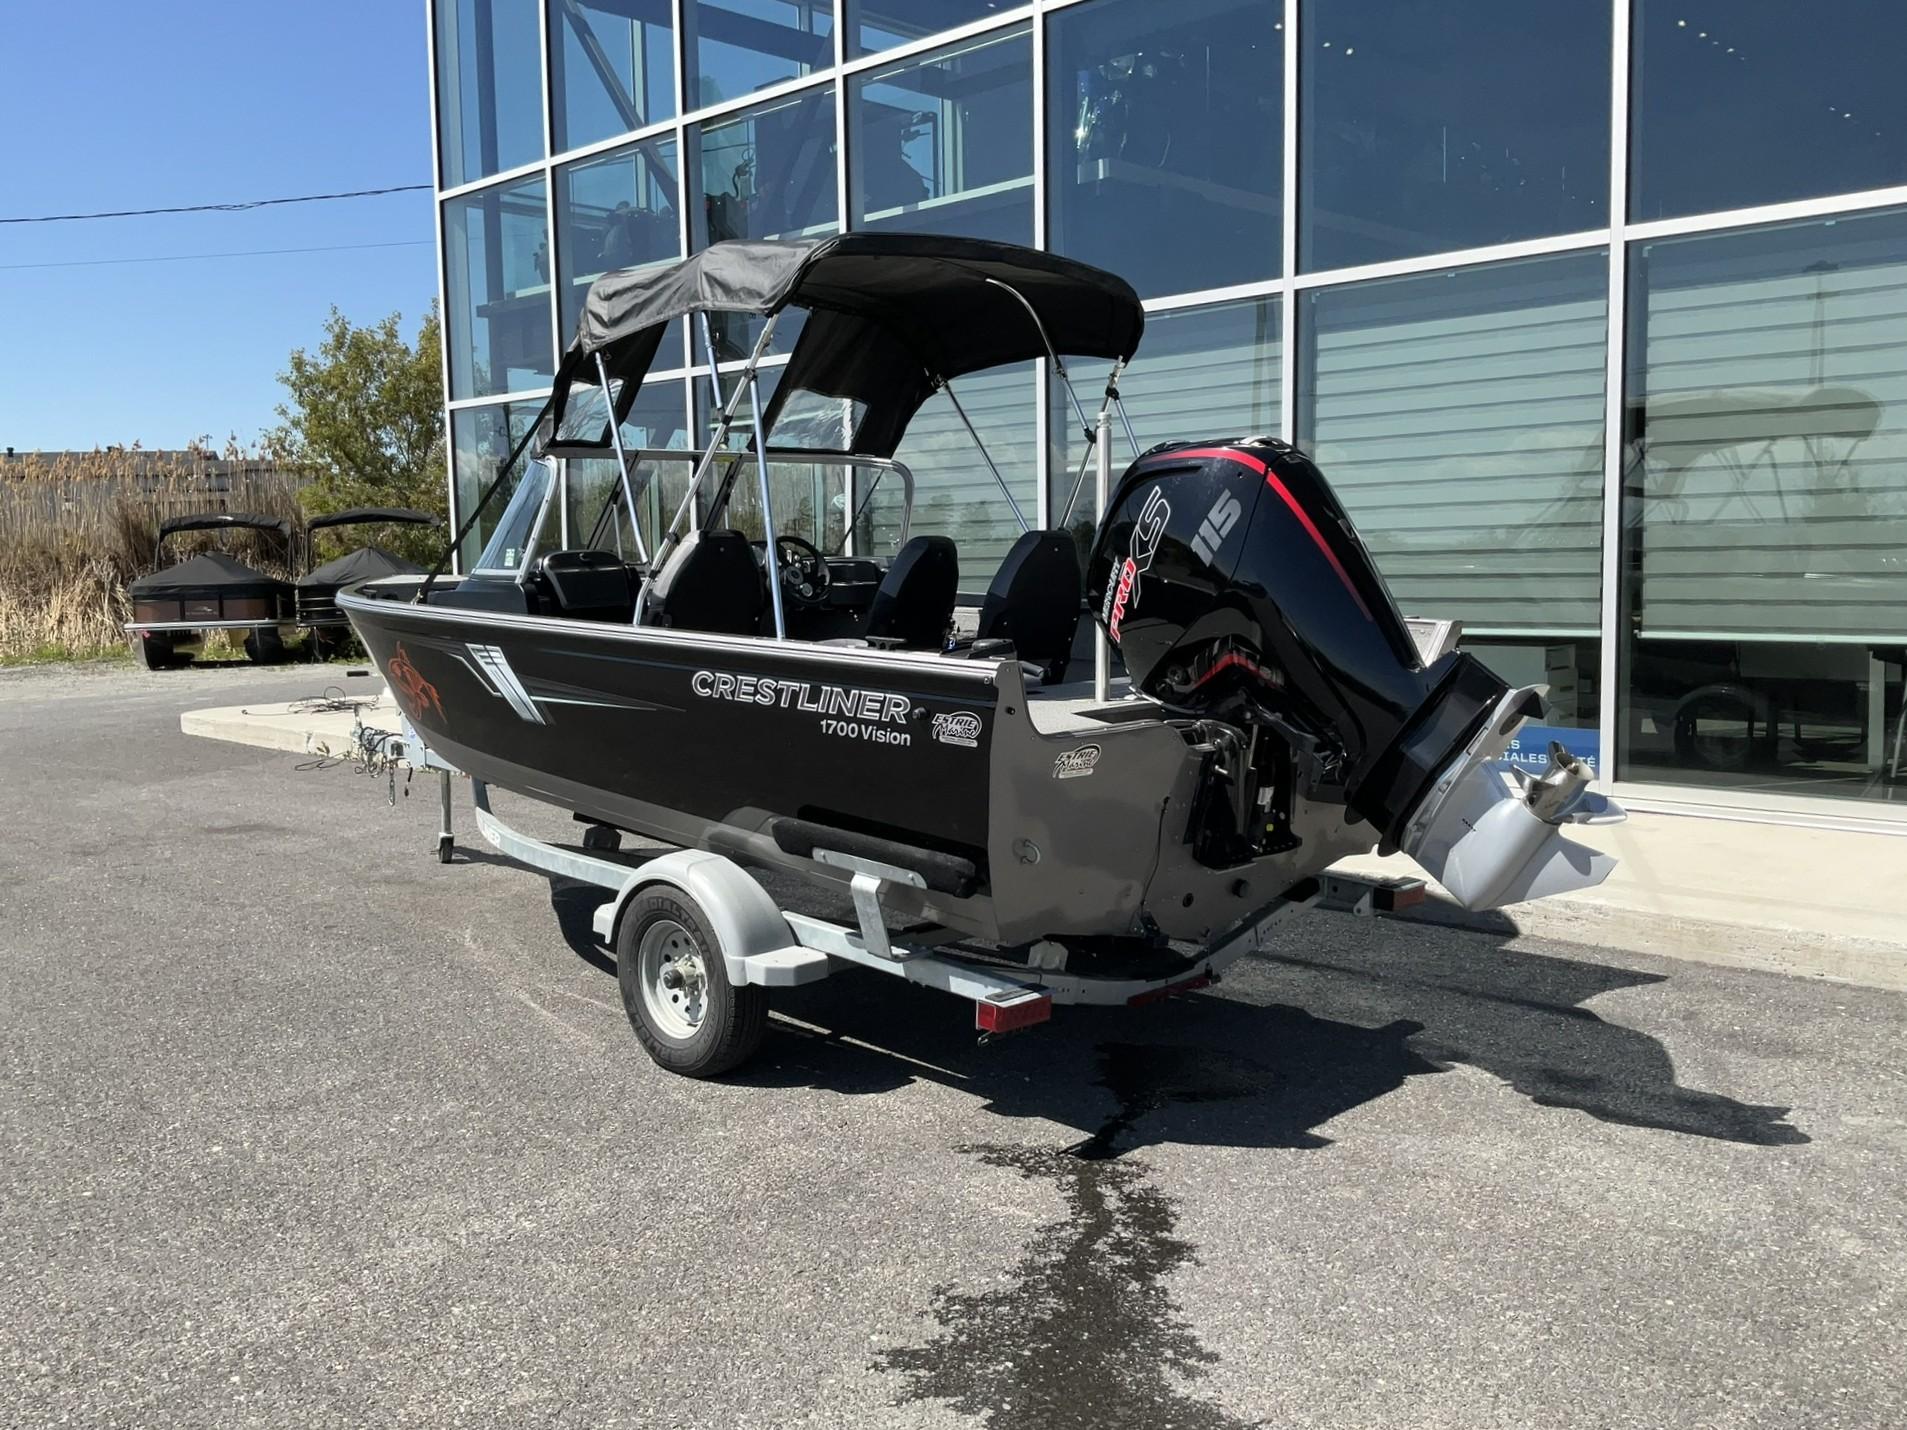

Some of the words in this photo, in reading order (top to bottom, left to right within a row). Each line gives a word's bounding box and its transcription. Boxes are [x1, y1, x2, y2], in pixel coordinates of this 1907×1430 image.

[1129, 485, 1171, 609] XS
[1190, 488, 1242, 567] 115
[1102, 555, 1121, 624] MERCURY
[692, 671, 911, 724] CRESTLINER
[933, 713, 979, 730] ESTRIE
[820, 719, 859, 738] 1700
[861, 725, 911, 746] Vision
[1499, 751, 1547, 764] IALES
